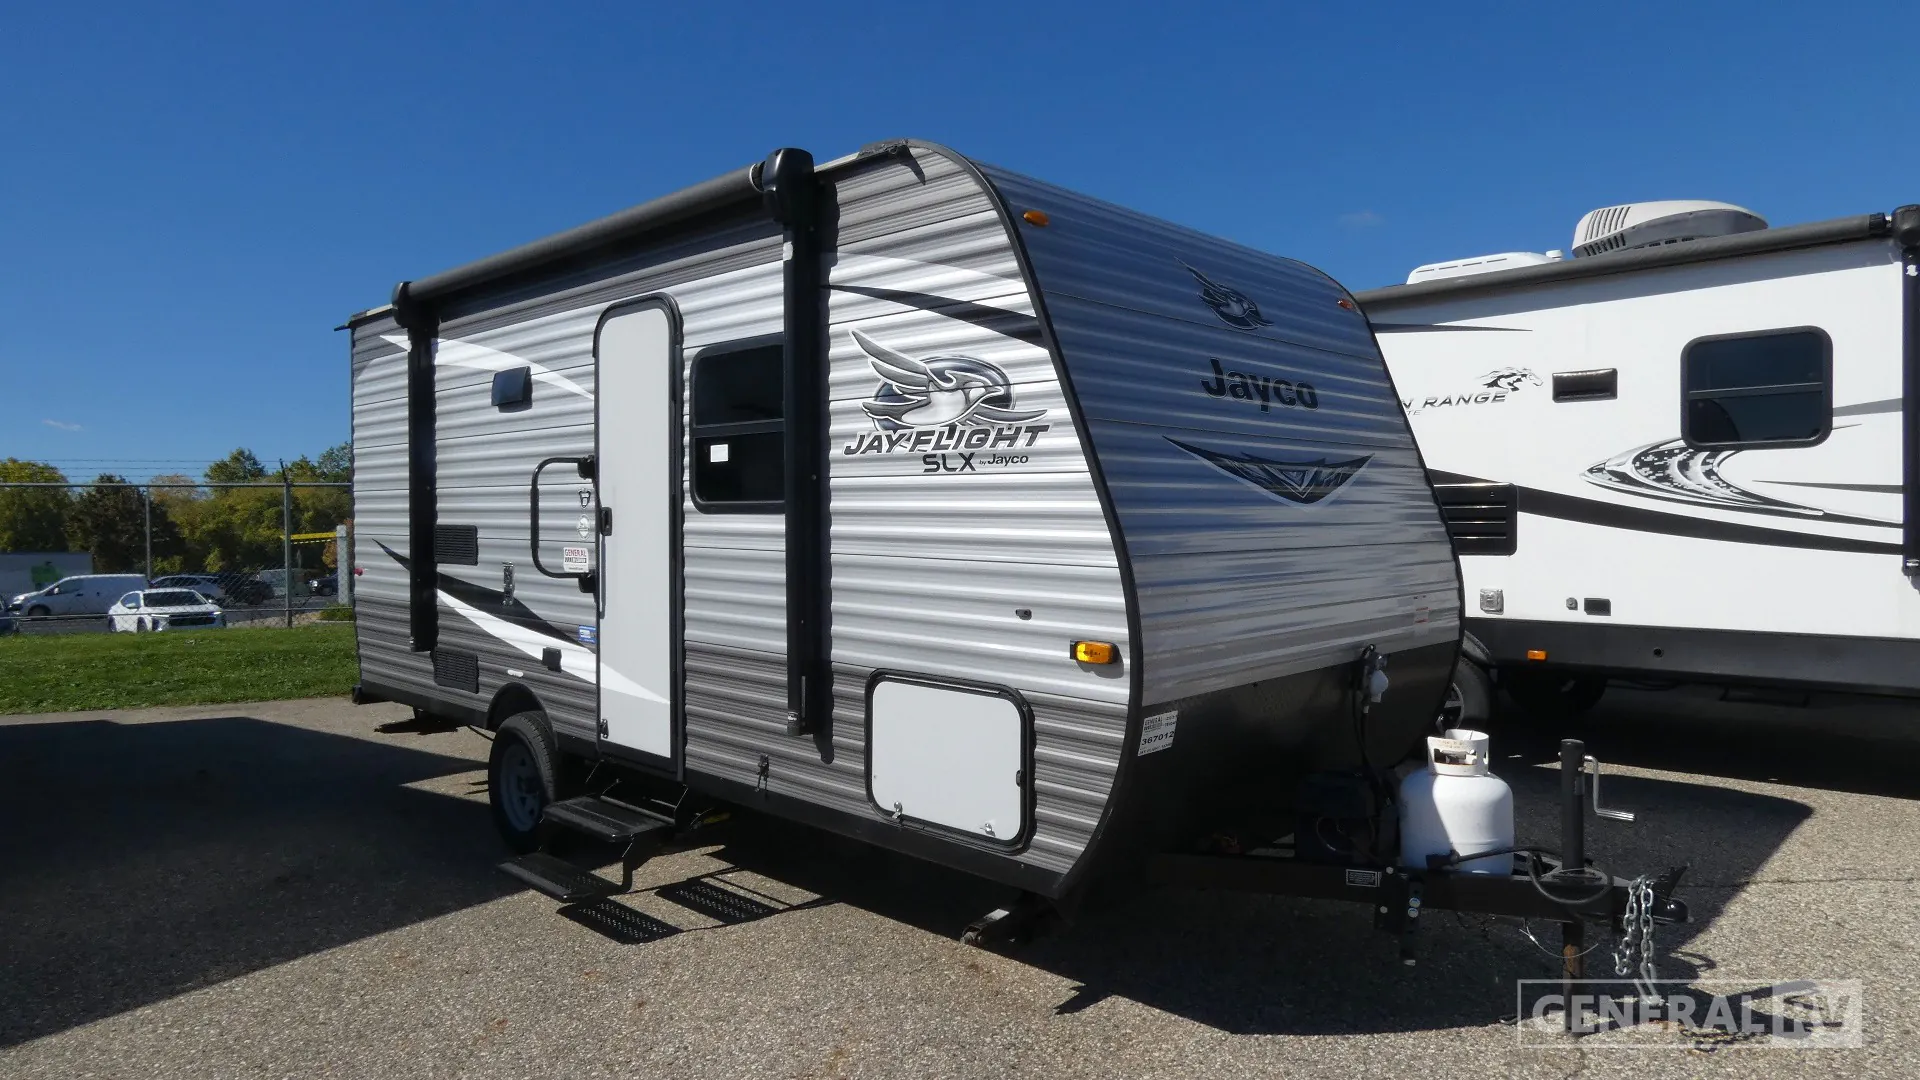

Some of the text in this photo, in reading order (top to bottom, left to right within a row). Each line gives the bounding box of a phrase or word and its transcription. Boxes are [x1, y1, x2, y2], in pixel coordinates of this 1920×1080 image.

[1200, 357, 1319, 414] Jayco
[1422, 391, 1506, 409] RANGE
[843, 424, 1051, 456] JAY FLIGHT
[922, 452, 977, 473] SLX
[988, 453, 1029, 467] Jayco
[1141, 730, 1175, 746] 367012
